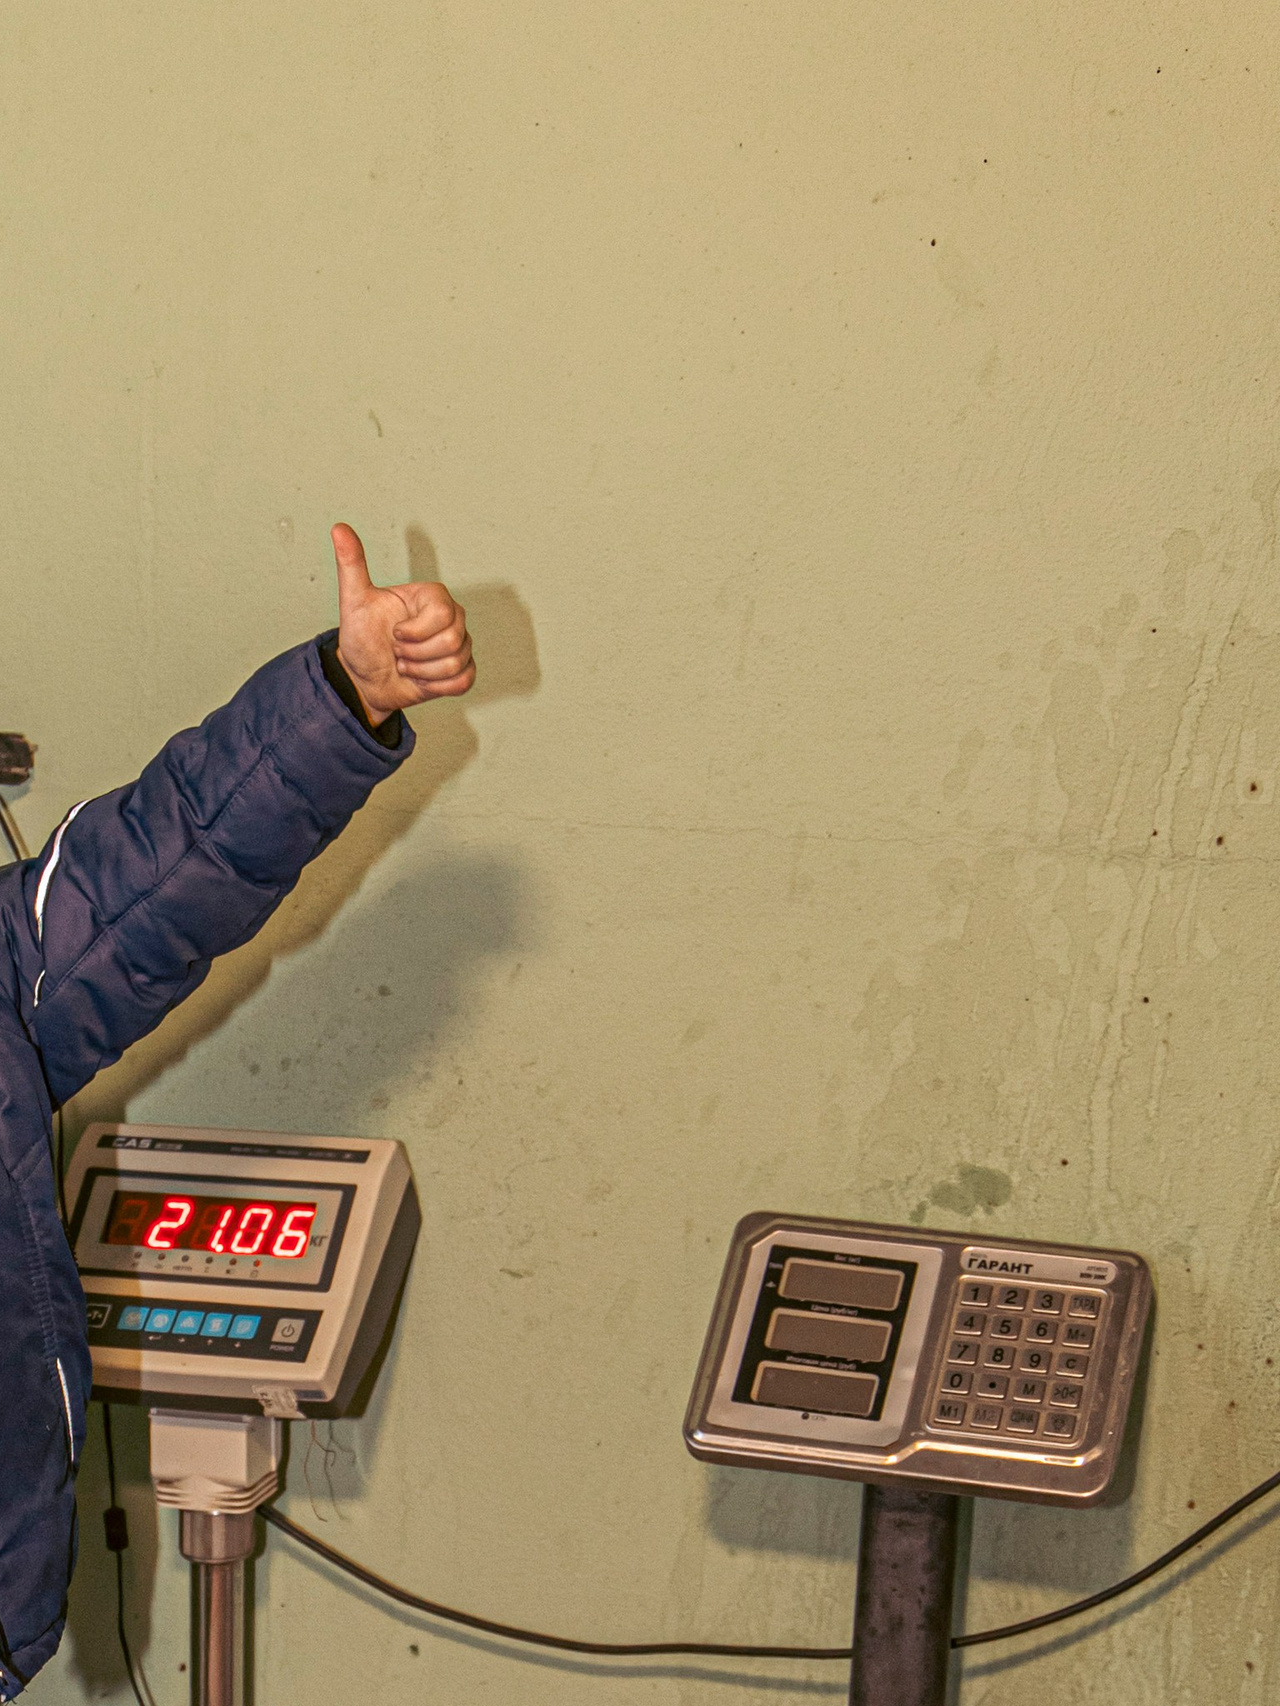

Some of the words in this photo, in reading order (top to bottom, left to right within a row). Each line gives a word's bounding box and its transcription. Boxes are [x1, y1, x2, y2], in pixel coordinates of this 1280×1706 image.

[112, 1138, 152, 1149] CAS
[147, 1201, 317, 1258] 21.06
[967, 1258, 1034, 1275] ГАРАНТ
[970, 1287, 980, 1301] 1
[1005, 1290, 1018, 1305] 2
[1041, 1294, 1054, 1309] 3
[1073, 1297, 1096, 1312] ТАРА
[963, 1316, 975, 1328] 4
[999, 1319, 1012, 1334] 5
[1036, 1322, 1049, 1337] 6
[956, 1344, 969, 1359] 7
[991, 1348, 1005, 1363] 8
[1029, 1354, 1042, 1368] 9
[950, 1373, 963, 1389] 0
[939, 1405, 959, 1418] M1
